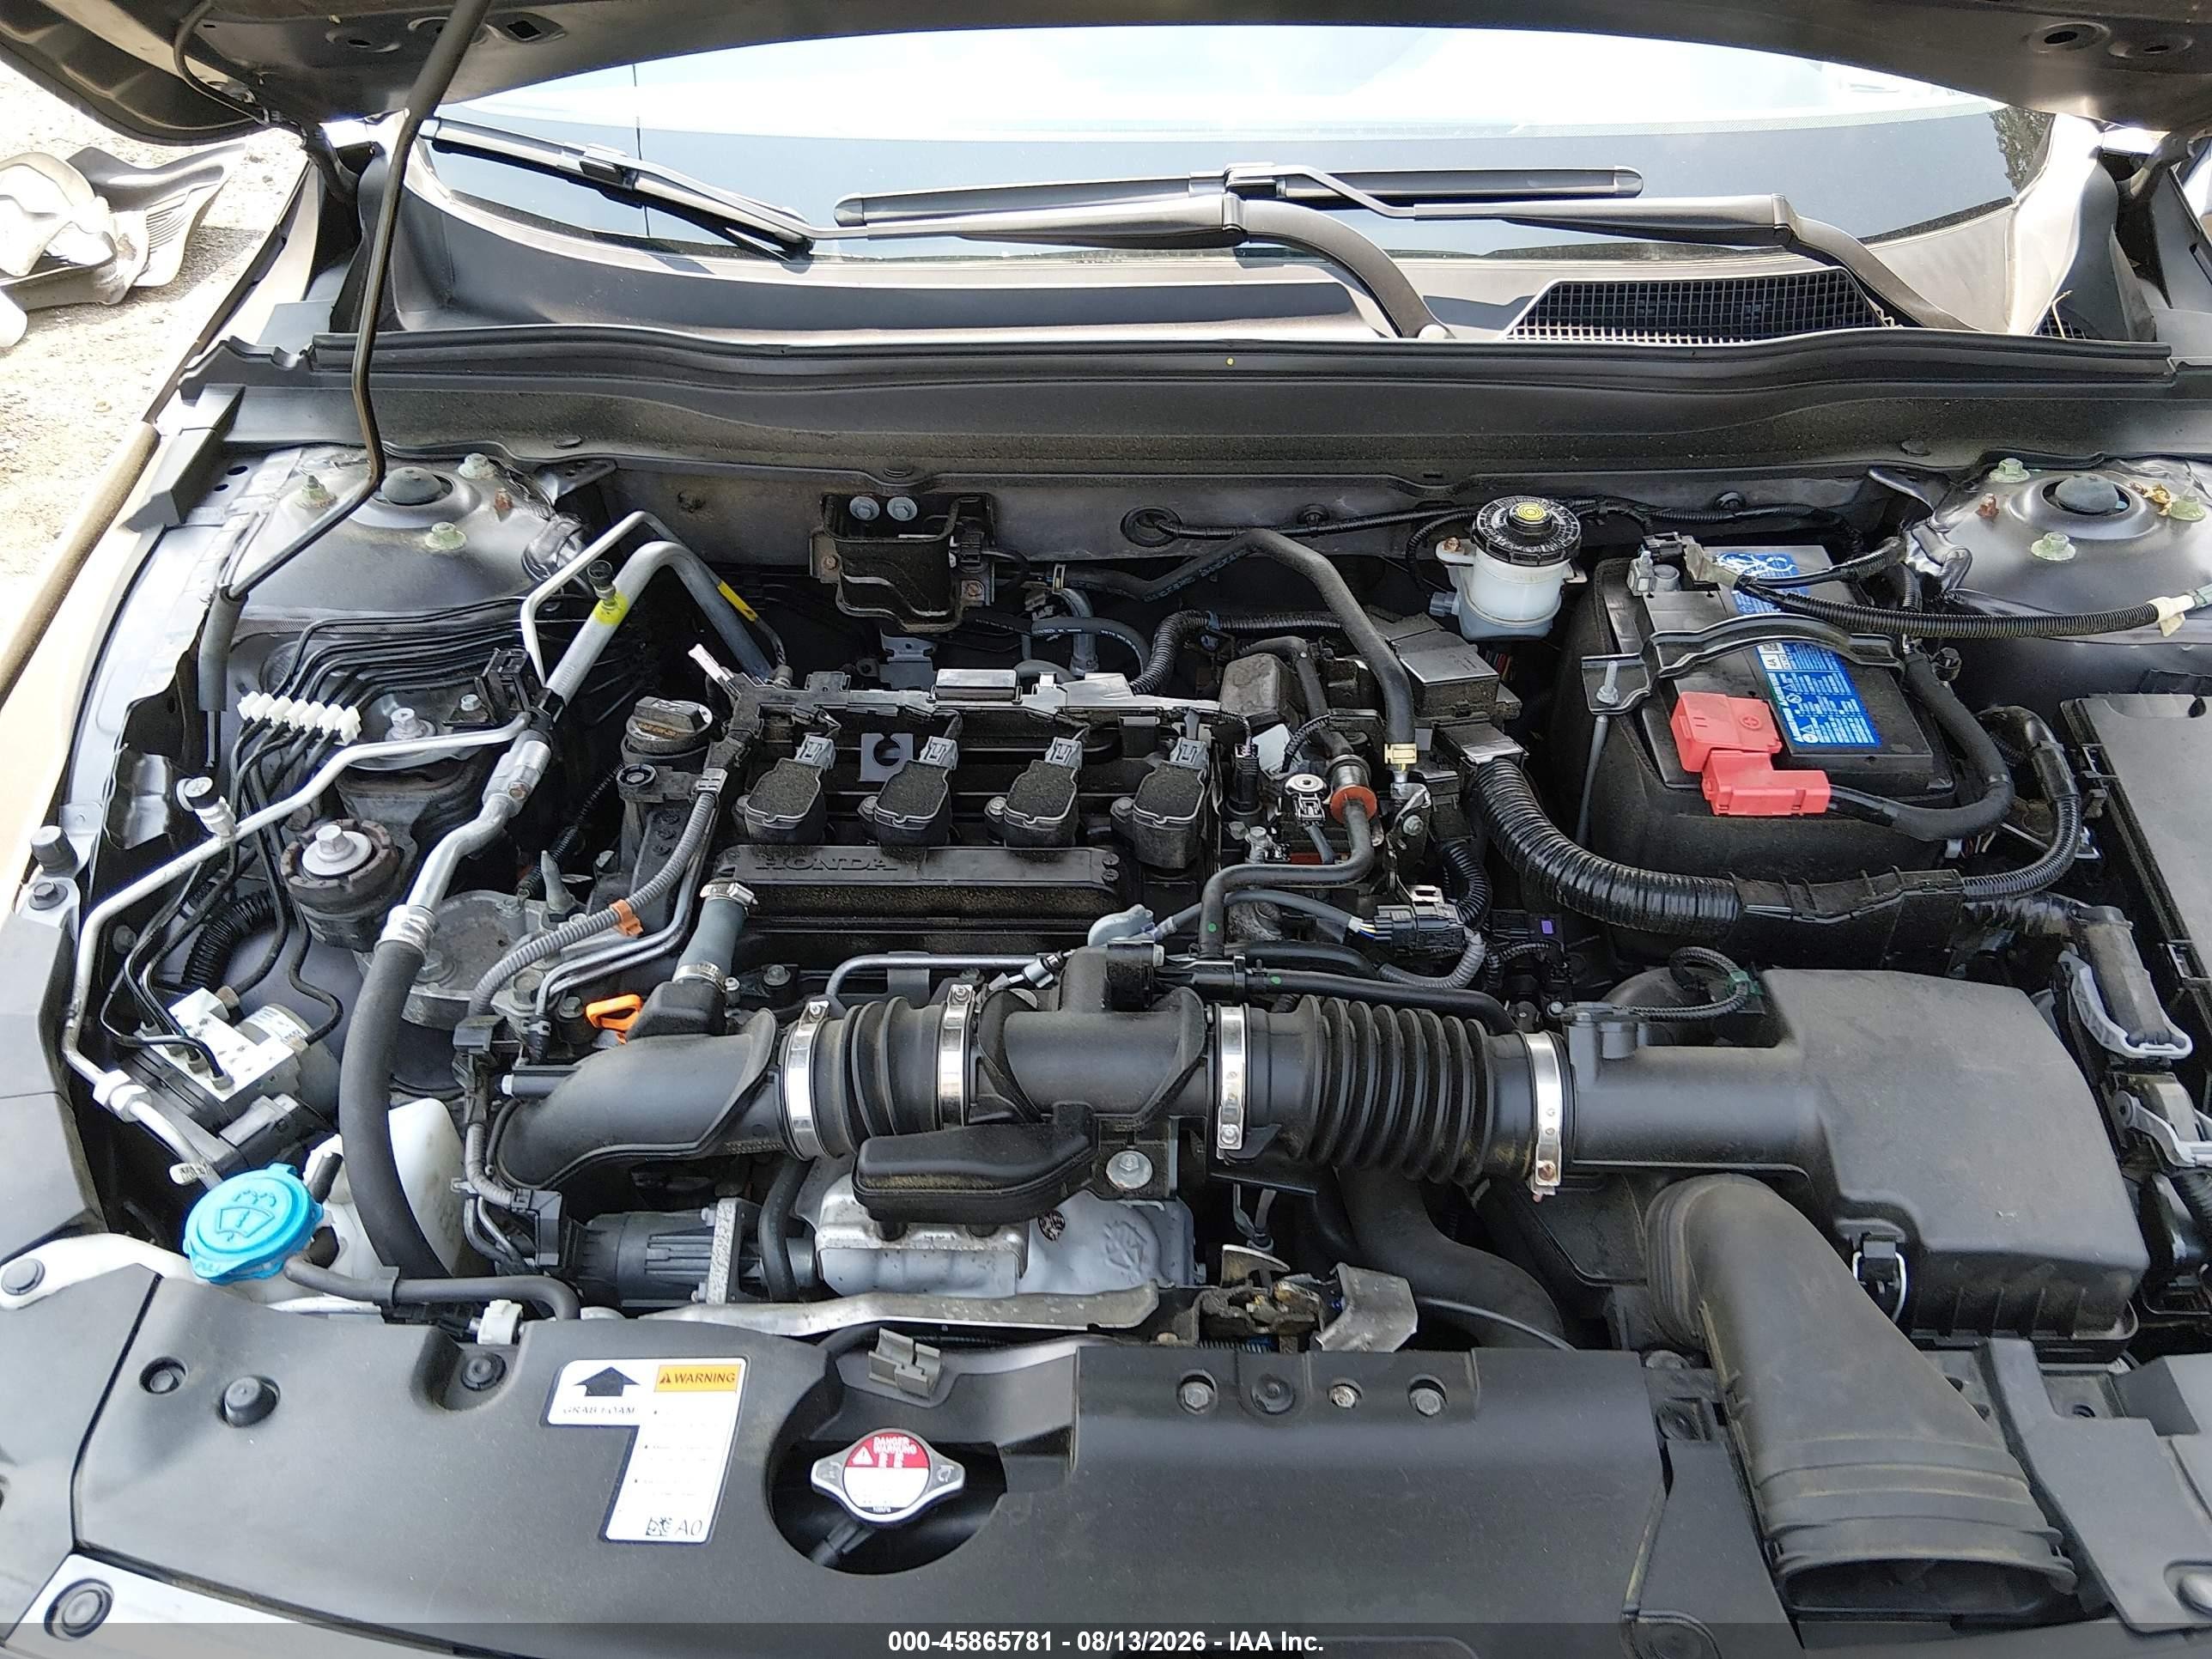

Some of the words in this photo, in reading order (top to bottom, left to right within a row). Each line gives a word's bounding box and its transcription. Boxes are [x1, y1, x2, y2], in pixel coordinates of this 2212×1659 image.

[755, 858, 898, 871] HONDA
[674, 1372, 736, 1384] WARNING
[873, 1436, 910, 1444] DANGER
